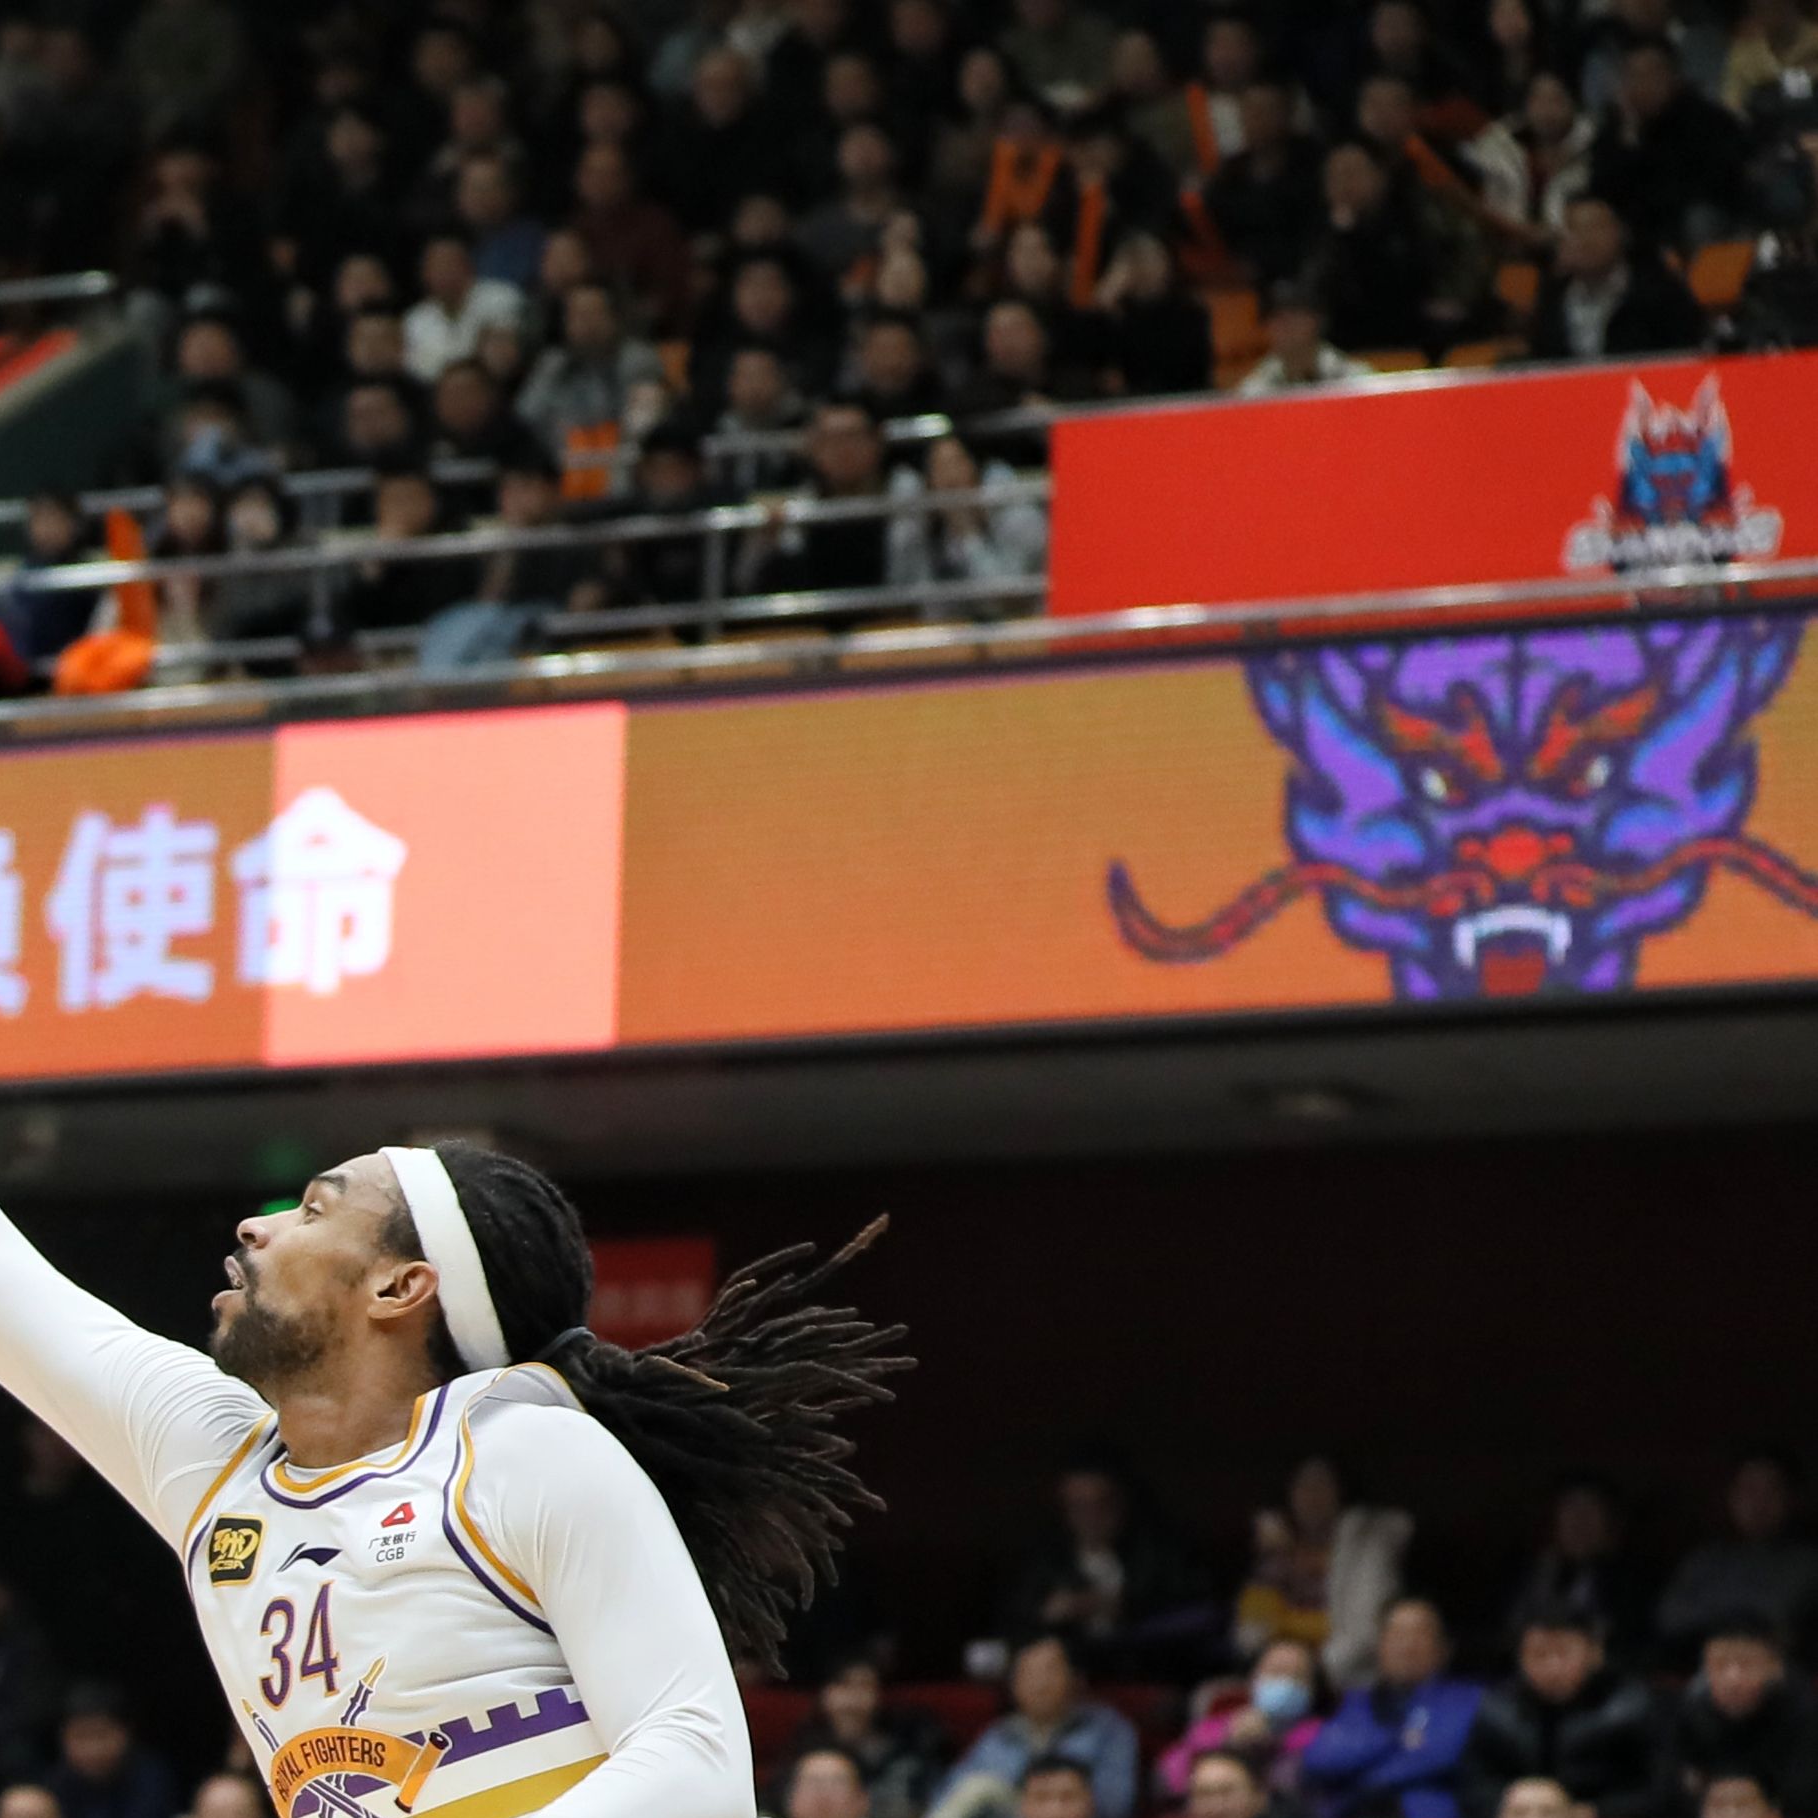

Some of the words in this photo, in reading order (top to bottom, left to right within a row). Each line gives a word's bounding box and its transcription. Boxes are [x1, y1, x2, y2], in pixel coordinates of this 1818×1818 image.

[375, 1546, 405, 1563] CGB
[259, 1579, 342, 1711] 34
[299, 1735, 386, 1768] FIGHTERS
